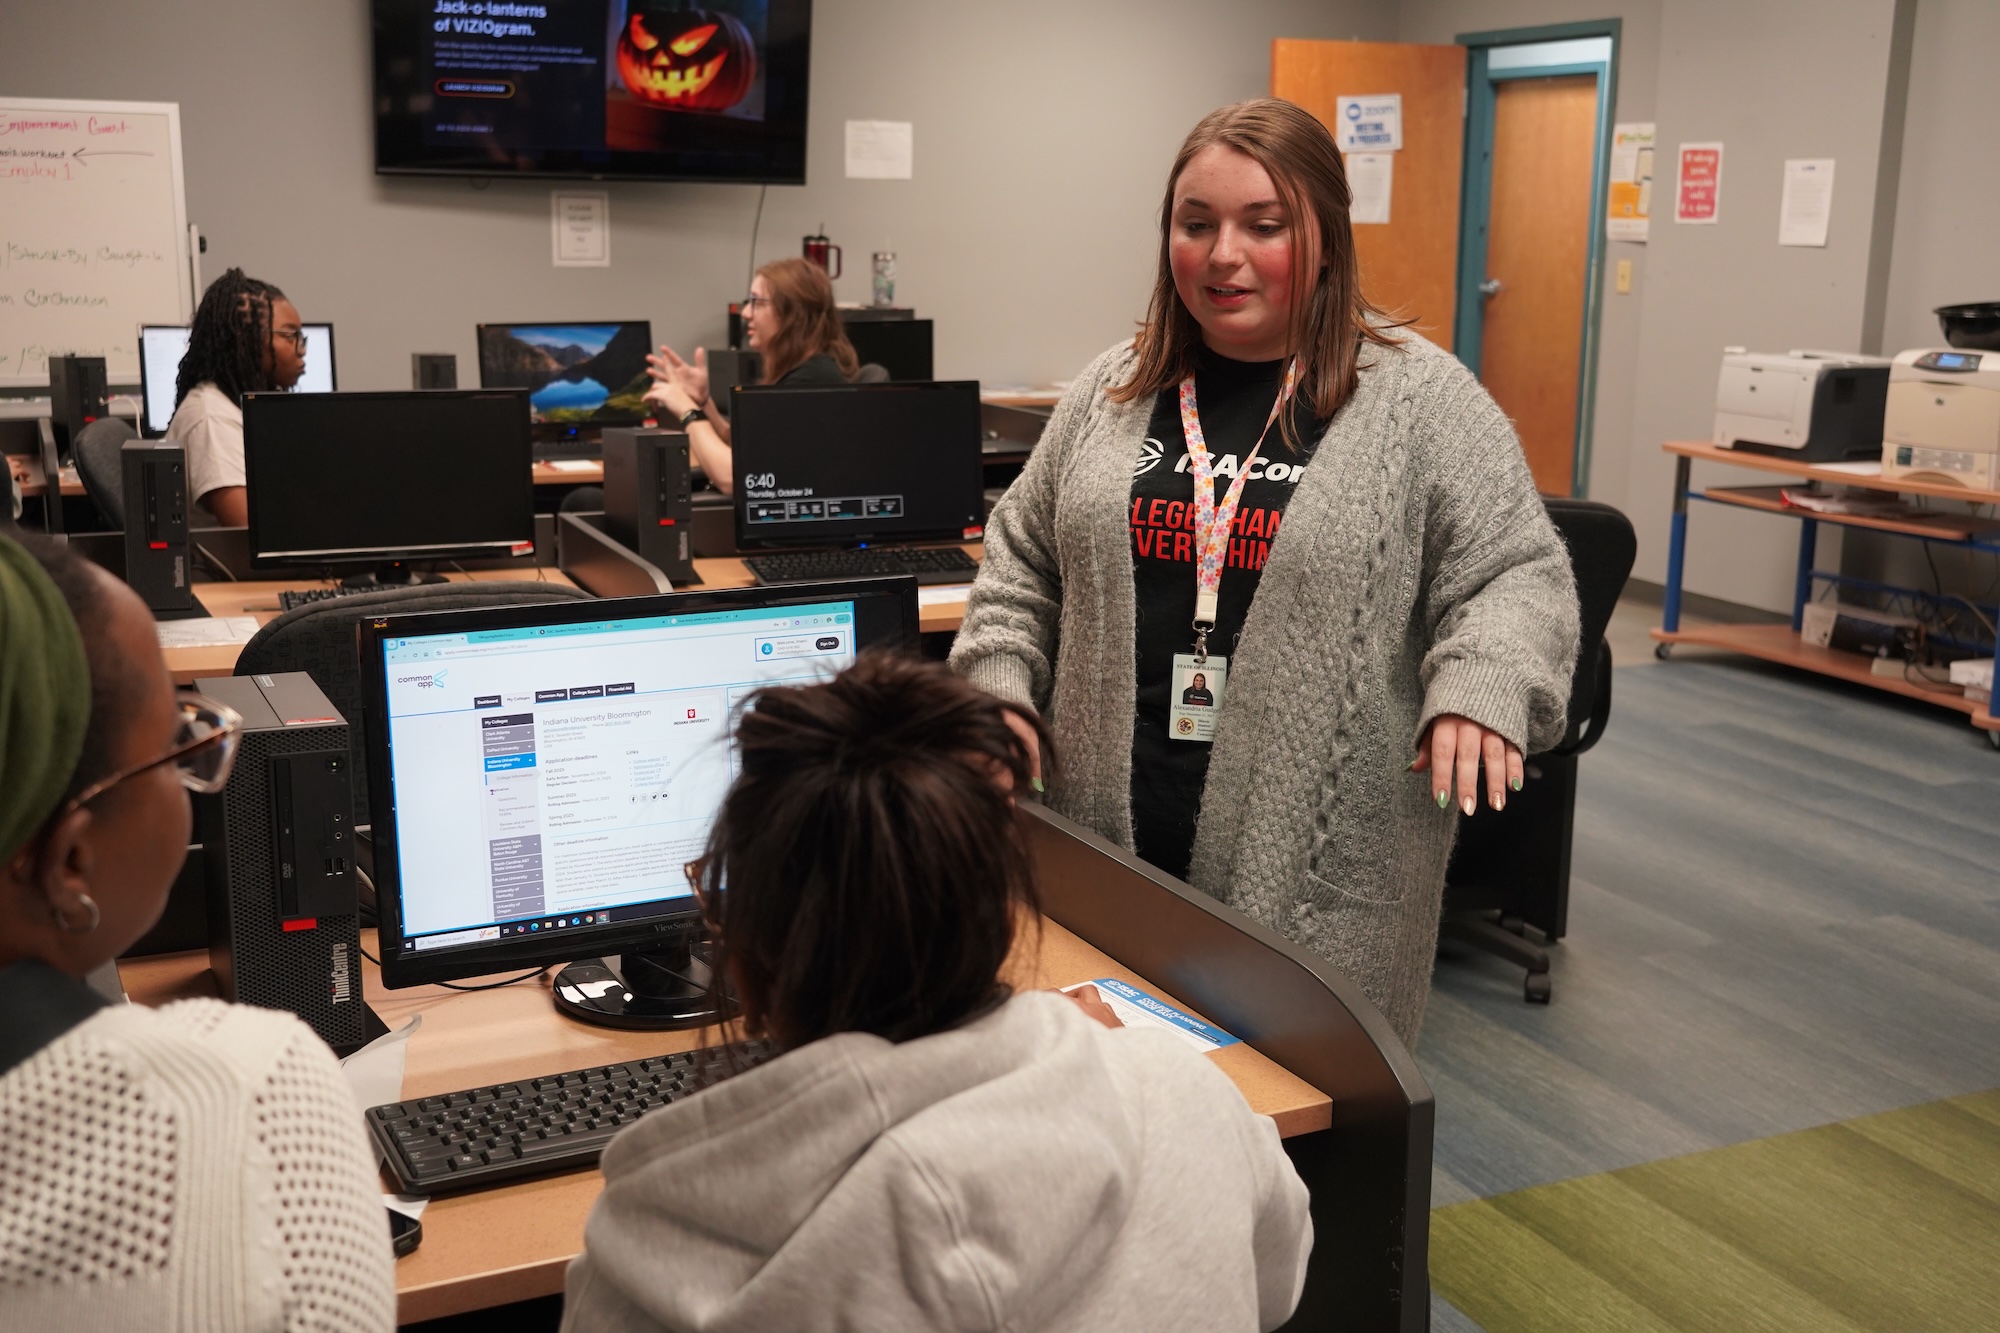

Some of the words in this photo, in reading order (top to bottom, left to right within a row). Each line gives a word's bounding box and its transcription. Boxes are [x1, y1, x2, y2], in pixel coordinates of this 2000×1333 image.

[434, 0, 547, 18] Jack-o-lanterns
[434, 18, 450, 32] of
[453, 20, 536, 37] VIZIOgram.
[745, 473, 776, 488] 6:40
[747, 490, 777, 498] Thursday,
[778, 489, 804, 497] October
[398, 675, 433, 683] common
[570, 714, 606, 723] University
[607, 710, 651, 719] Bloomington
[654, 921, 695, 932] ViewSonic
[331, 943, 350, 1004] ThinkCentre
